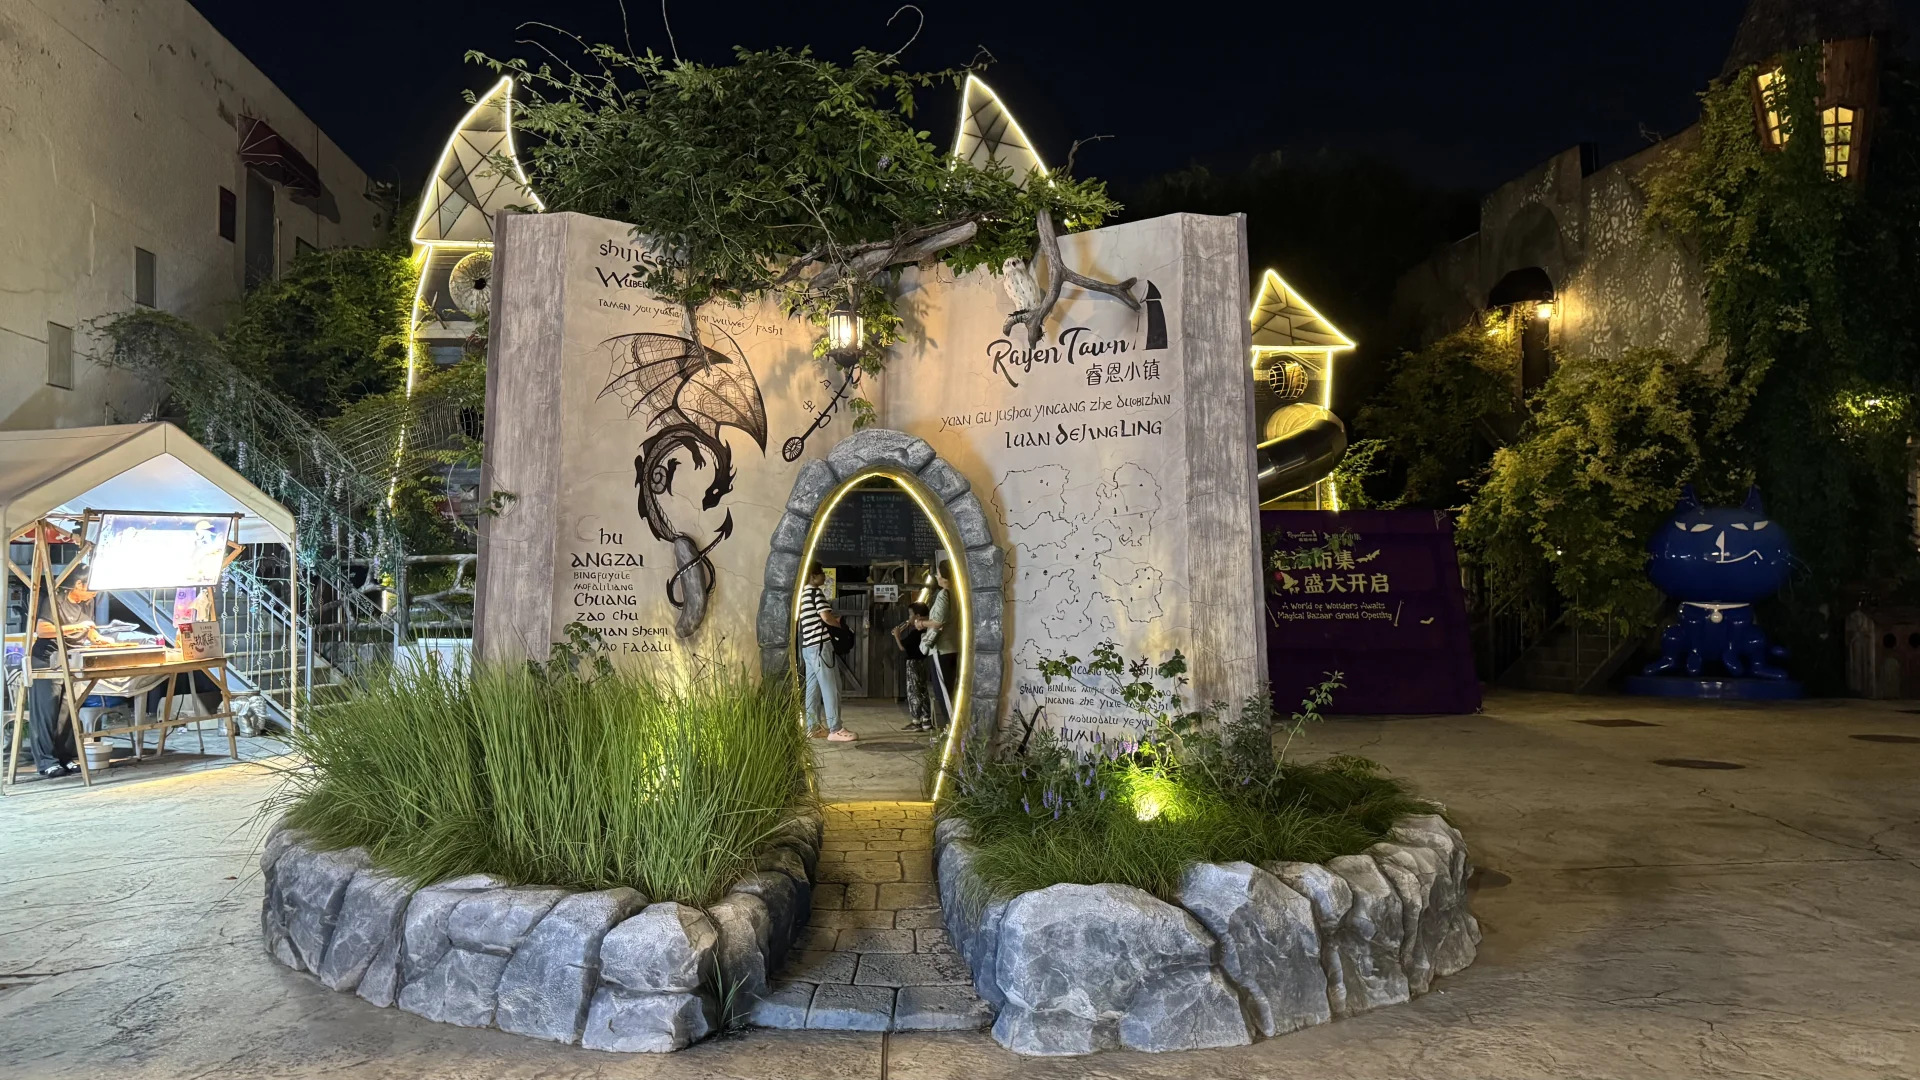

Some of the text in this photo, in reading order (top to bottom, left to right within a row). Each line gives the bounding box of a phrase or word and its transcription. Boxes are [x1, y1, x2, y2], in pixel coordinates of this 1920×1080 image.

[1085, 359, 1161, 386] 睿恩小镇
[1304, 572, 1389, 594] 盛大开启
[1290, 602, 1312, 610] World
[1314, 603, 1323, 611] of
[1325, 602, 1358, 610] Wonders
[1360, 602, 1385, 610] Awaits
[1278, 611, 1392, 621] Magical Bazaar Grand Opening
